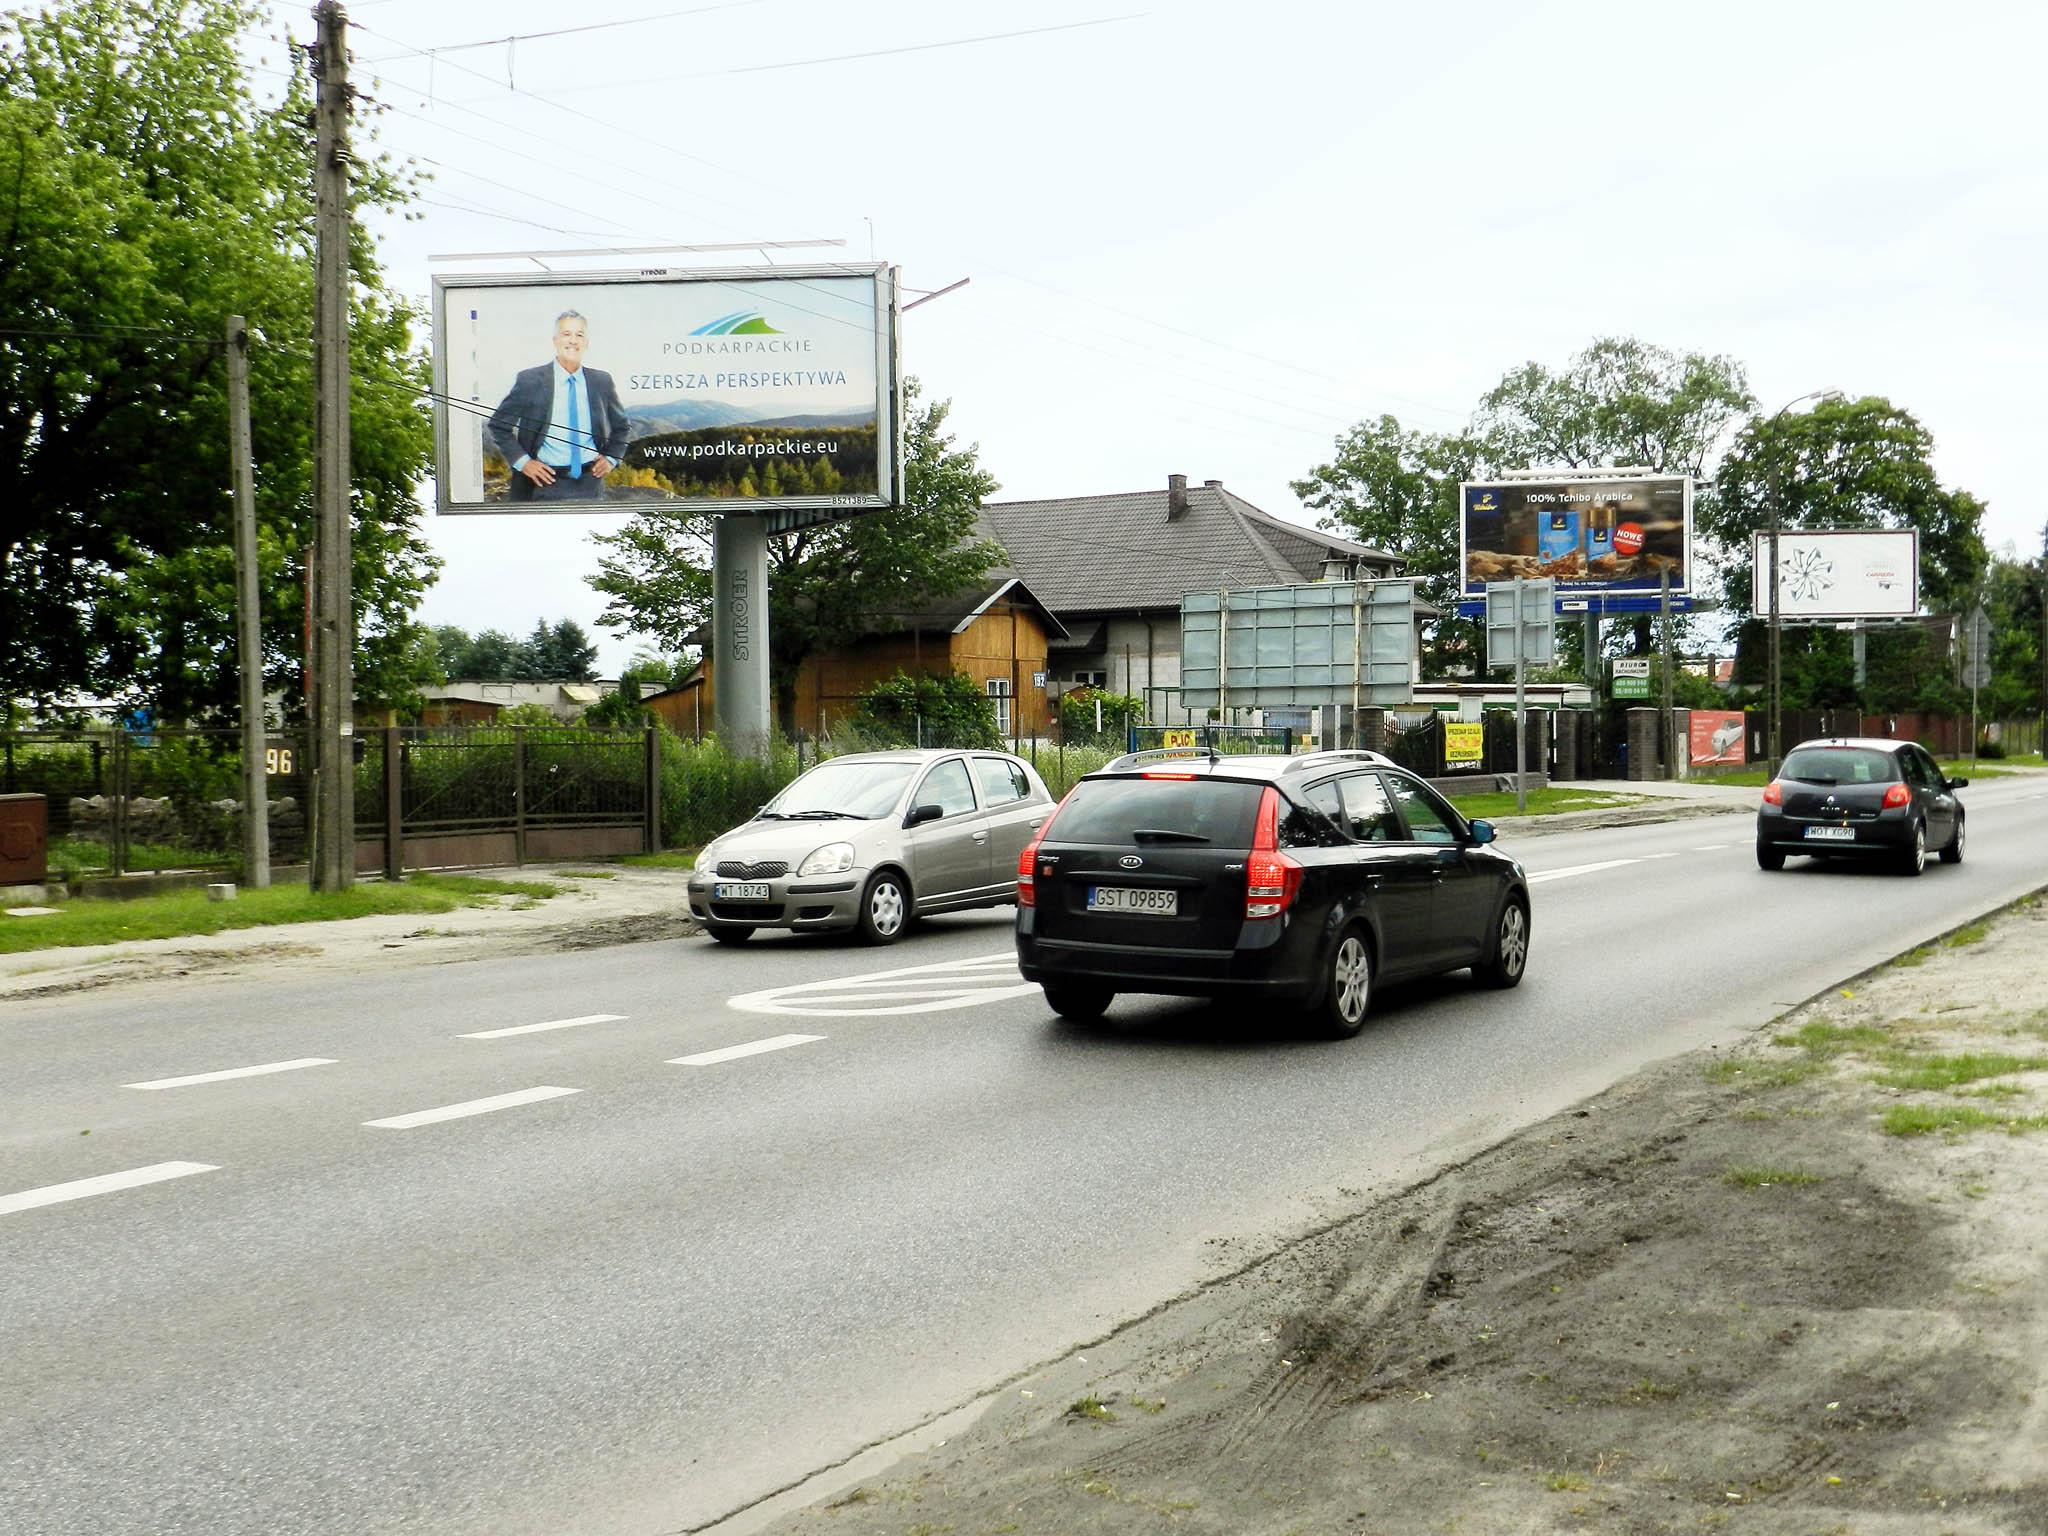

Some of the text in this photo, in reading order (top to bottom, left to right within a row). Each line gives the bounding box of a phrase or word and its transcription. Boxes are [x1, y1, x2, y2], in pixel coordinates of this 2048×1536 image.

[663, 339, 812, 355] PODKARPACKIE
[630, 370, 847, 390] SZERSZA PERSPEKTYWA
[643, 439, 838, 459] www.podkarpackie.eu
[1526, 493, 1633, 503] 100% Tchibo Arabica
[1616, 529, 1643, 542] NOWE
[721, 885, 768, 897] WT 18743
[1096, 888, 1176, 909] GST 09859
